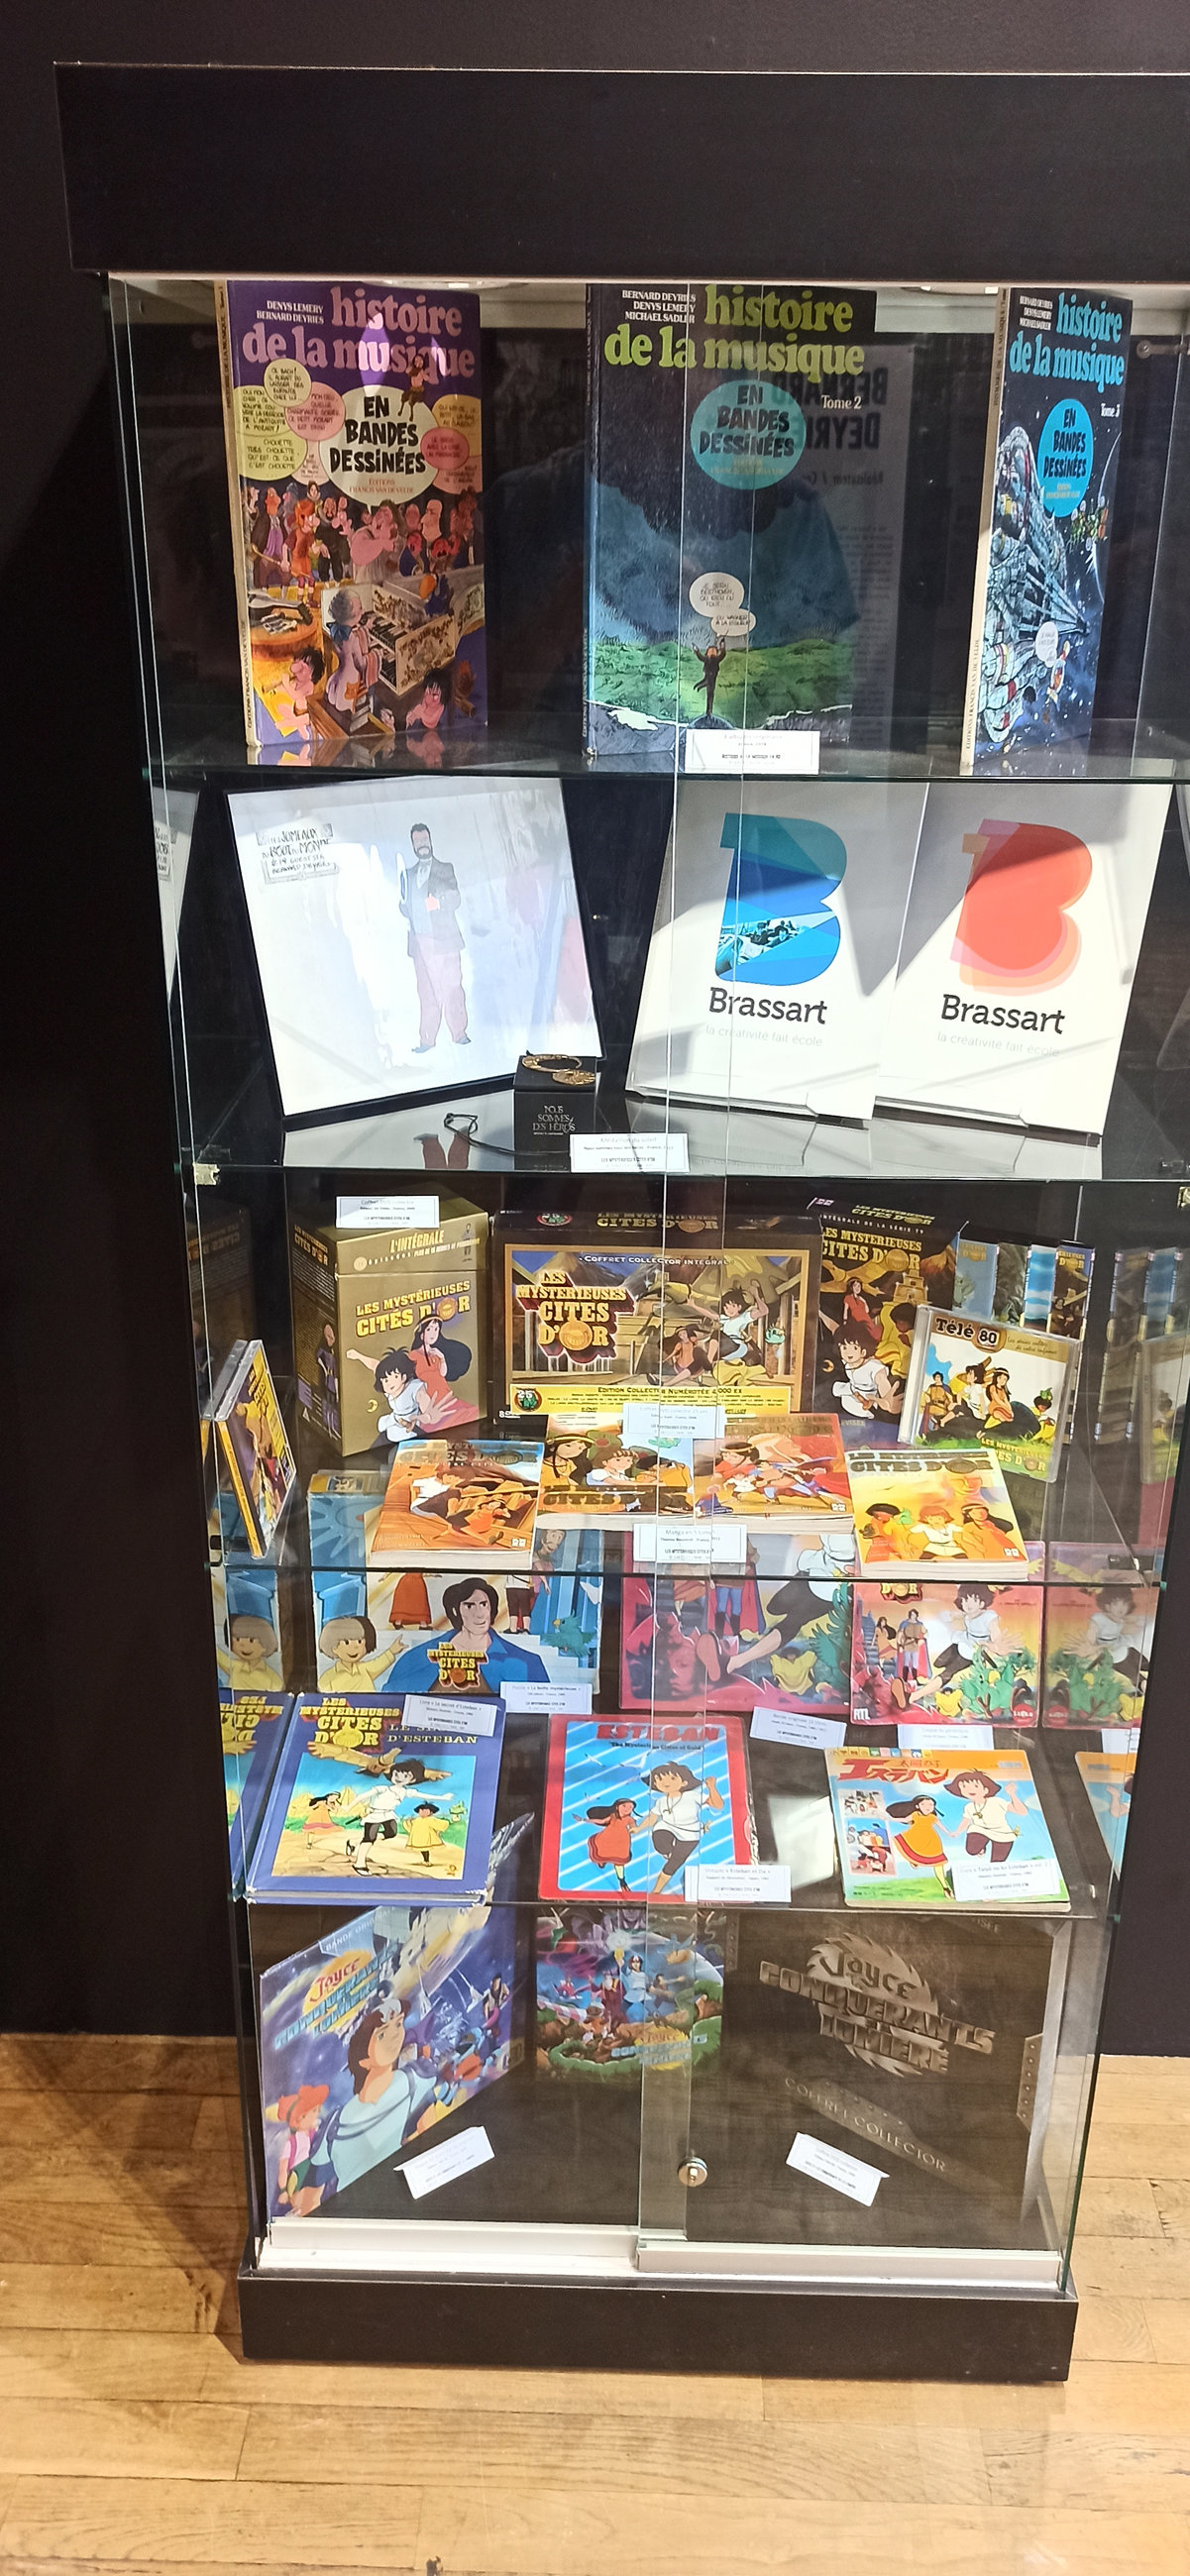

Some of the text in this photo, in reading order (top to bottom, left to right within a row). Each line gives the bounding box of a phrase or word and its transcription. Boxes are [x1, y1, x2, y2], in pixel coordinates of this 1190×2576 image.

[622, 290, 661, 300] BERNARD
[1020, 295, 1036, 306] BERNARD
[257, 310, 291, 322] BERNARD
[267, 300, 323, 314] DENYS LEMERY
[330, 285, 462, 337] histoire
[625, 311, 662, 322] MICHAEL
[634, 301, 661, 311] DENYS
[704, 284, 853, 333] histoire
[1056, 292, 1122, 343] histoire
[242, 322, 475, 385] de la musique
[604, 323, 864, 383] de la musique
[1010, 330, 1124, 393] de la musique
[736, 385, 763, 405] EN
[821, 394, 862, 410] Tome 2
[364, 395, 389, 418] EN
[1101, 403, 1115, 417] Tome
[716, 405, 790, 433] BANDES
[1063, 408, 1076, 428] EN
[344, 418, 418, 447] BANDES
[1052, 430, 1086, 453] BANDES
[709, 987, 827, 1024] Brassart
[941, 994, 1065, 1034] Brassart
[705, 1023, 823, 1047] la créativité fait école
[937, 1031, 1060, 1057] la créativité fait école
[596, 1218, 657, 1227] CITES
[851, 1208, 893, 1220] CITES
[389, 1230, 444, 1253] L'INTÉGRALE
[841, 1230, 922, 1252] MYSTERIEUSES
[584, 1254, 625, 1263] COFFRET
[627, 1255, 681, 1265] COLLECTOR
[872, 1248, 920, 1272] D'OR
[541, 1271, 567, 1284] LES
[357, 1280, 470, 1317] LES MYSTÉRIEUSES
[515, 1286, 627, 1301] MYSTERIEUSES
[357, 1296, 470, 1337] CITÉS D'OR
[539, 1302, 610, 1323] CITES
[538, 1321, 609, 1351] D'OR
[935, 1318, 998, 1344] Télé 80
[517, 1390, 533, 1399] 25
[982, 1438, 995, 1447] LES
[850, 1460, 921, 1472] CITES
[440, 1658, 475, 1668] CITES
[299, 1706, 400, 1717] MYSTERIEUSES
[854, 1708, 870, 1721] RTL
[317, 1717, 381, 1730] CITES
[596, 1724, 719, 1741] ESTEBAN
[314, 1728, 379, 1748] D'OR
[387, 1735, 479, 1744] D'ESTEBAN
[838, 1758, 949, 1783] エステバン
[325, 1931, 353, 1951] BANDE
[309, 1957, 361, 2002] Joyce
[819, 1952, 916, 1998] Joyce
[759, 1961, 996, 2054] CONQUERANTS
[785, 2078, 847, 2118] COFFRET
[854, 2117, 946, 2172] COLLECTOR
